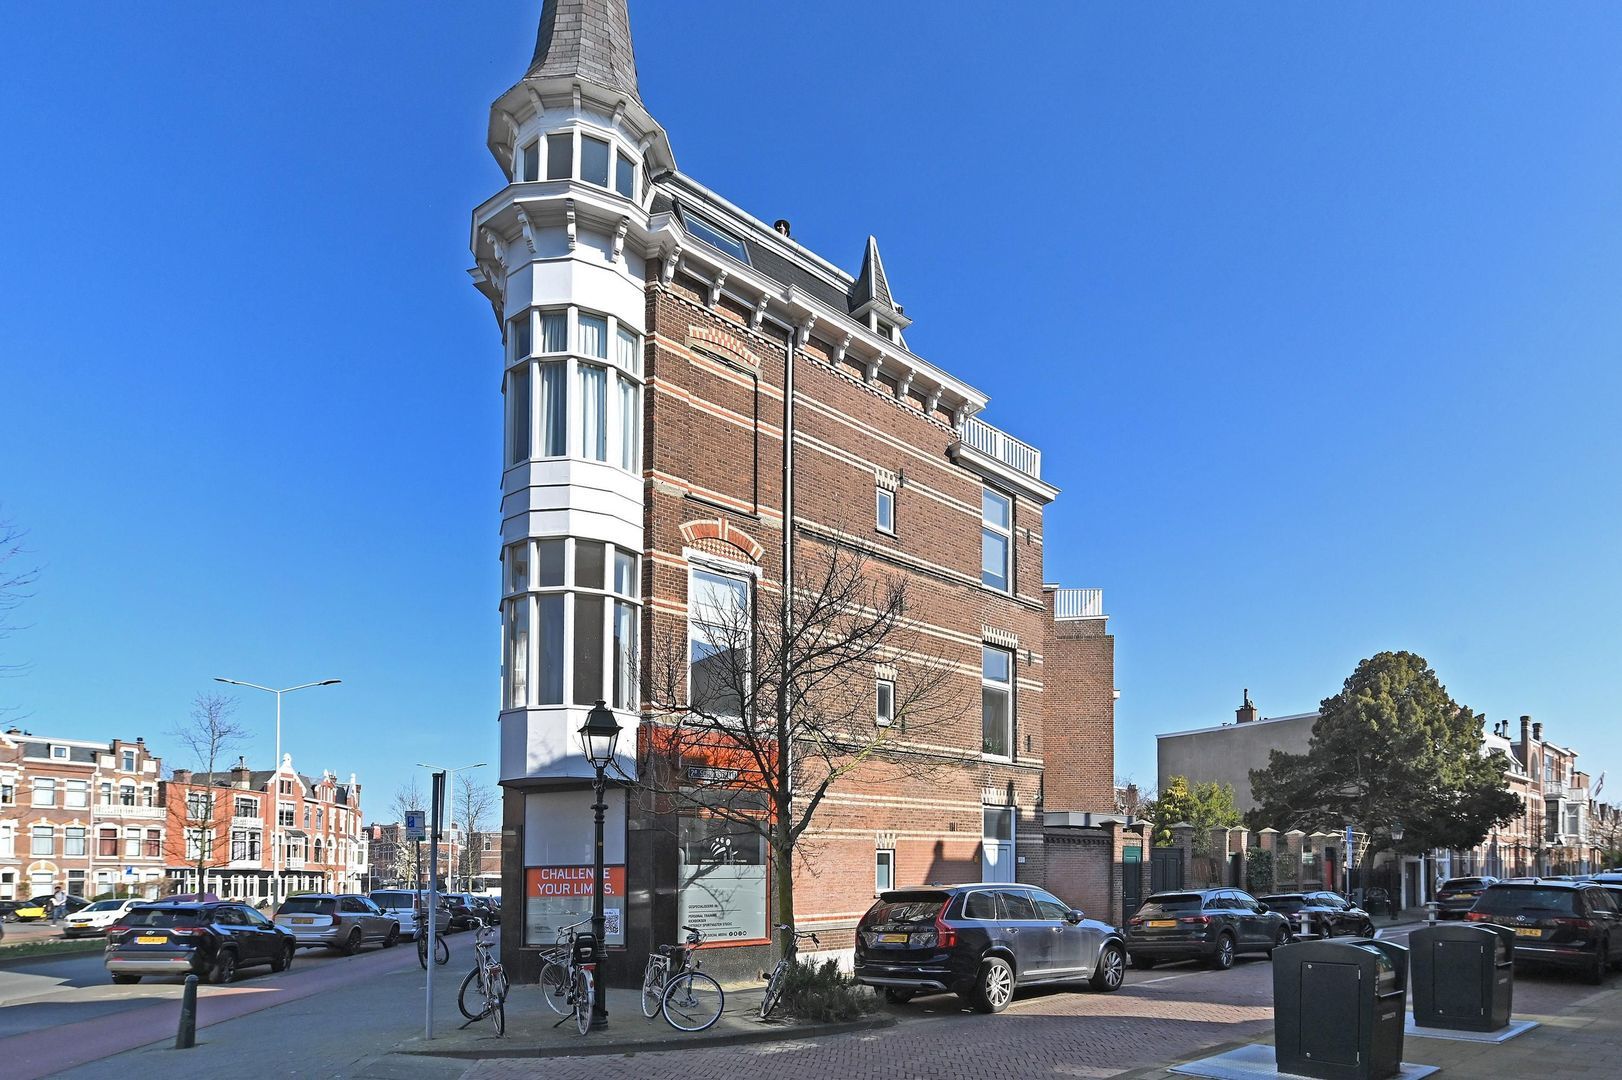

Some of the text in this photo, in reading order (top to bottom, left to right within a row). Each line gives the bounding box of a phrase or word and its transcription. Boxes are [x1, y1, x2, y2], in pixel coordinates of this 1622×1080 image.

[541, 867, 611, 880] CHALLENE
[537, 883, 615, 895] YOUR LIMS.
